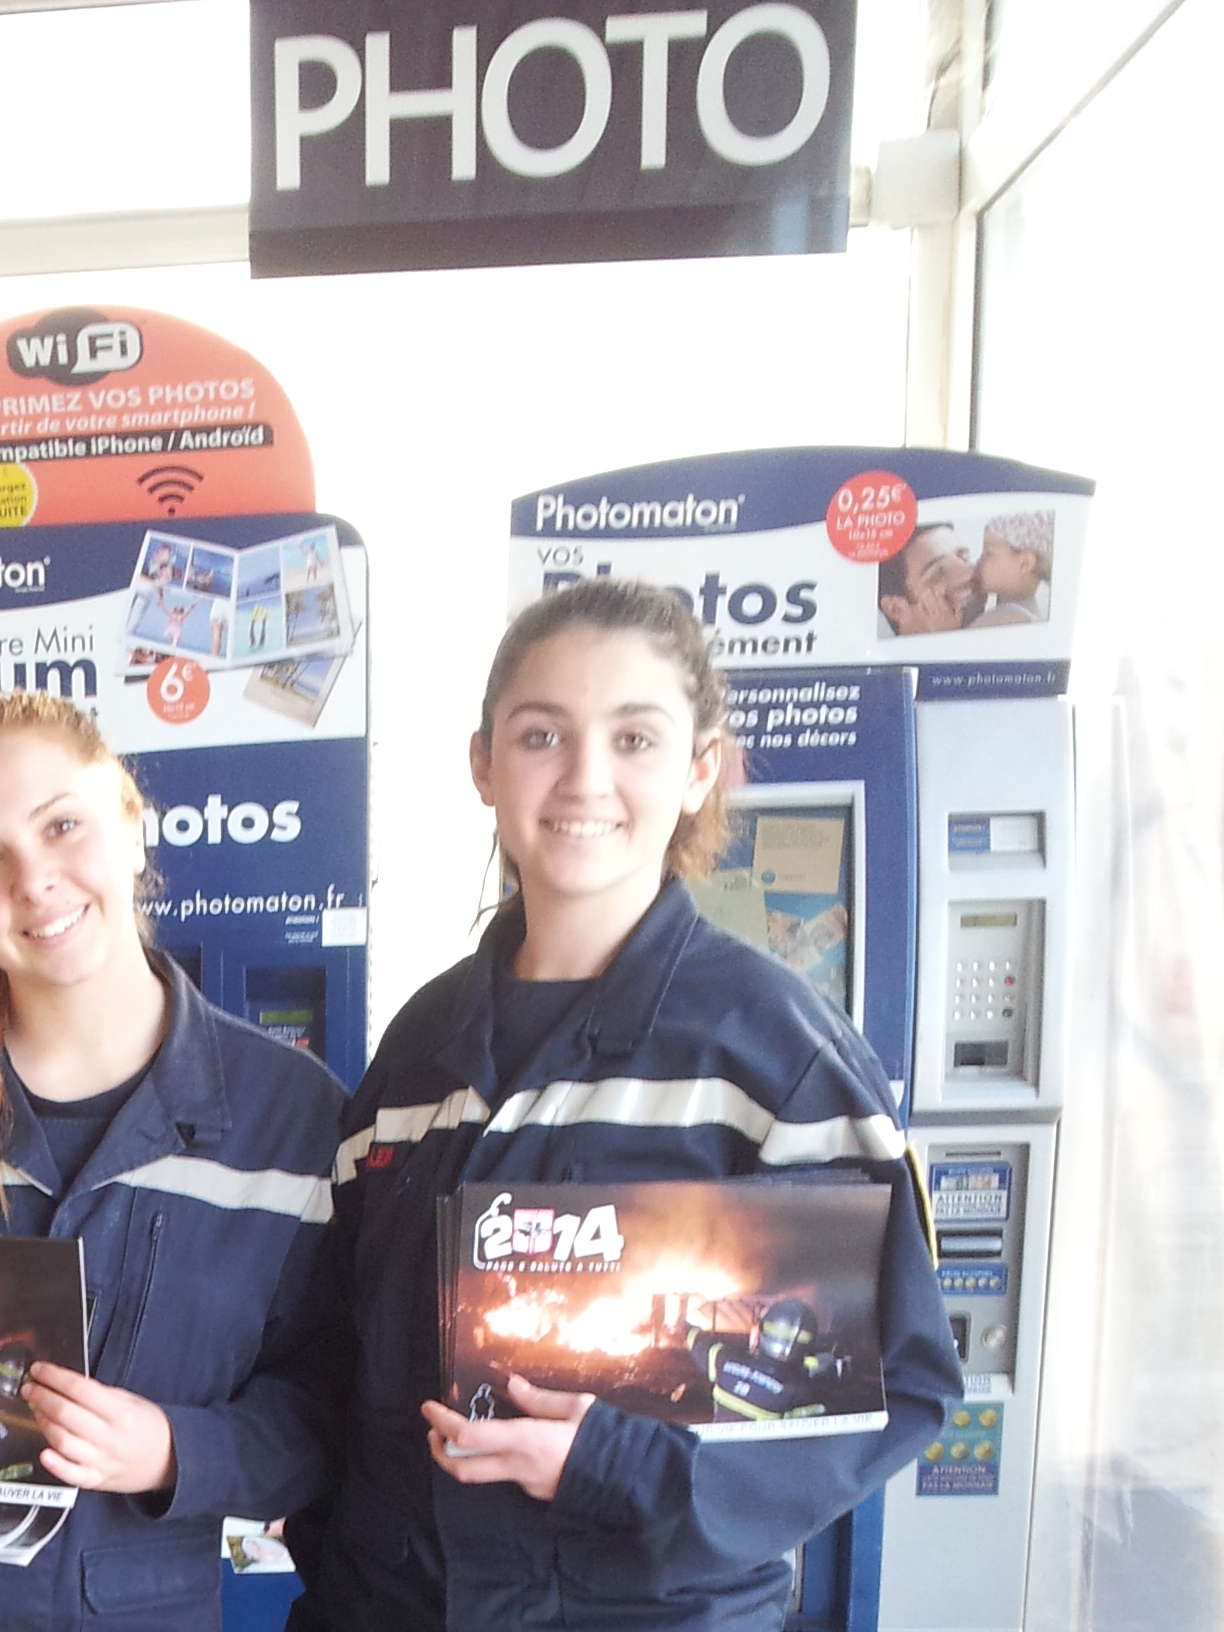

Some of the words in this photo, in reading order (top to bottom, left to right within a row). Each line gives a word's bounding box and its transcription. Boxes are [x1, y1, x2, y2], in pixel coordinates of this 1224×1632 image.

[274, 2, 831, 190] PHOTO
[89, 387, 142, 409] VOS
[148, 378, 255, 405] PHOTOS
[37, 414, 60, 434] de
[66, 410, 117, 431] votre
[121, 402, 244, 431] smartphone
[91, 431, 163, 456] iPhone
[535, 493, 739, 532] Photomaton
[836, 515, 854, 530] LA
[857, 510, 906, 528] PHOTO
[33, 624, 95, 655] Mini
[724, 681, 861, 705] ersonnalisez
[766, 702, 859, 733] photos
[760, 733, 793, 749] nos
[797, 727, 857, 749] décors
[480, 1203, 625, 1262] 2014
[32, 1488, 47, 1500] LA
[47, 1490, 64, 1503] VIE
